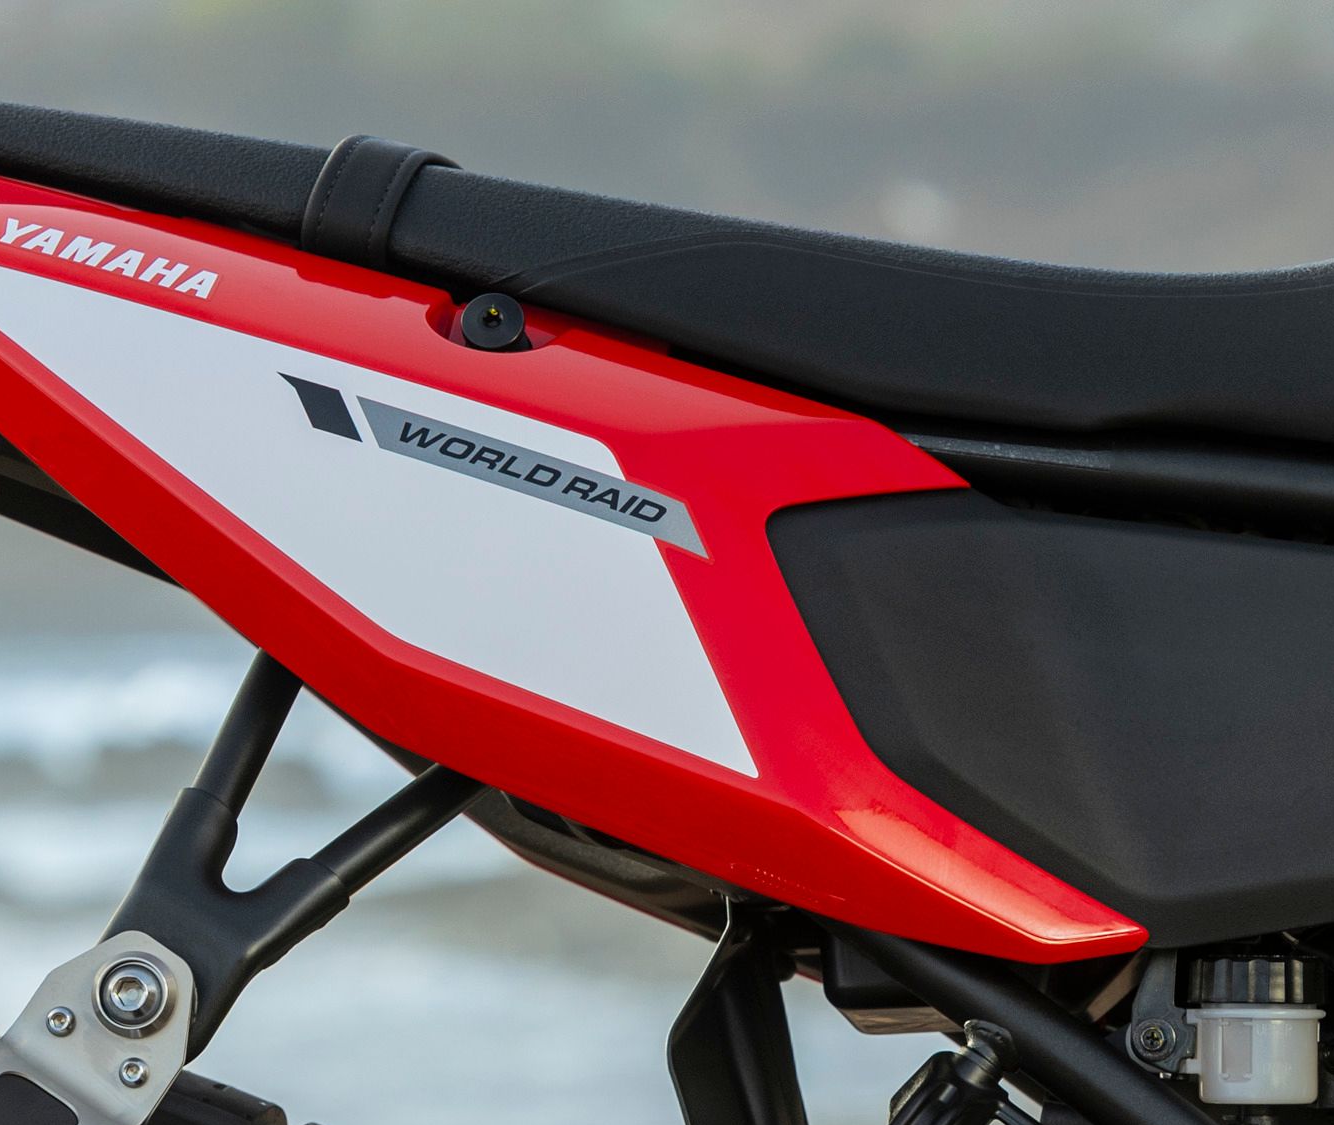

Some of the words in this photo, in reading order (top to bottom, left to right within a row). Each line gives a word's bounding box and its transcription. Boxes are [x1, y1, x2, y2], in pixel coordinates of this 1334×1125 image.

[0, 217, 219, 300] YAMAHA
[399, 421, 562, 488] WORLD
[561, 475, 668, 523] RAID
